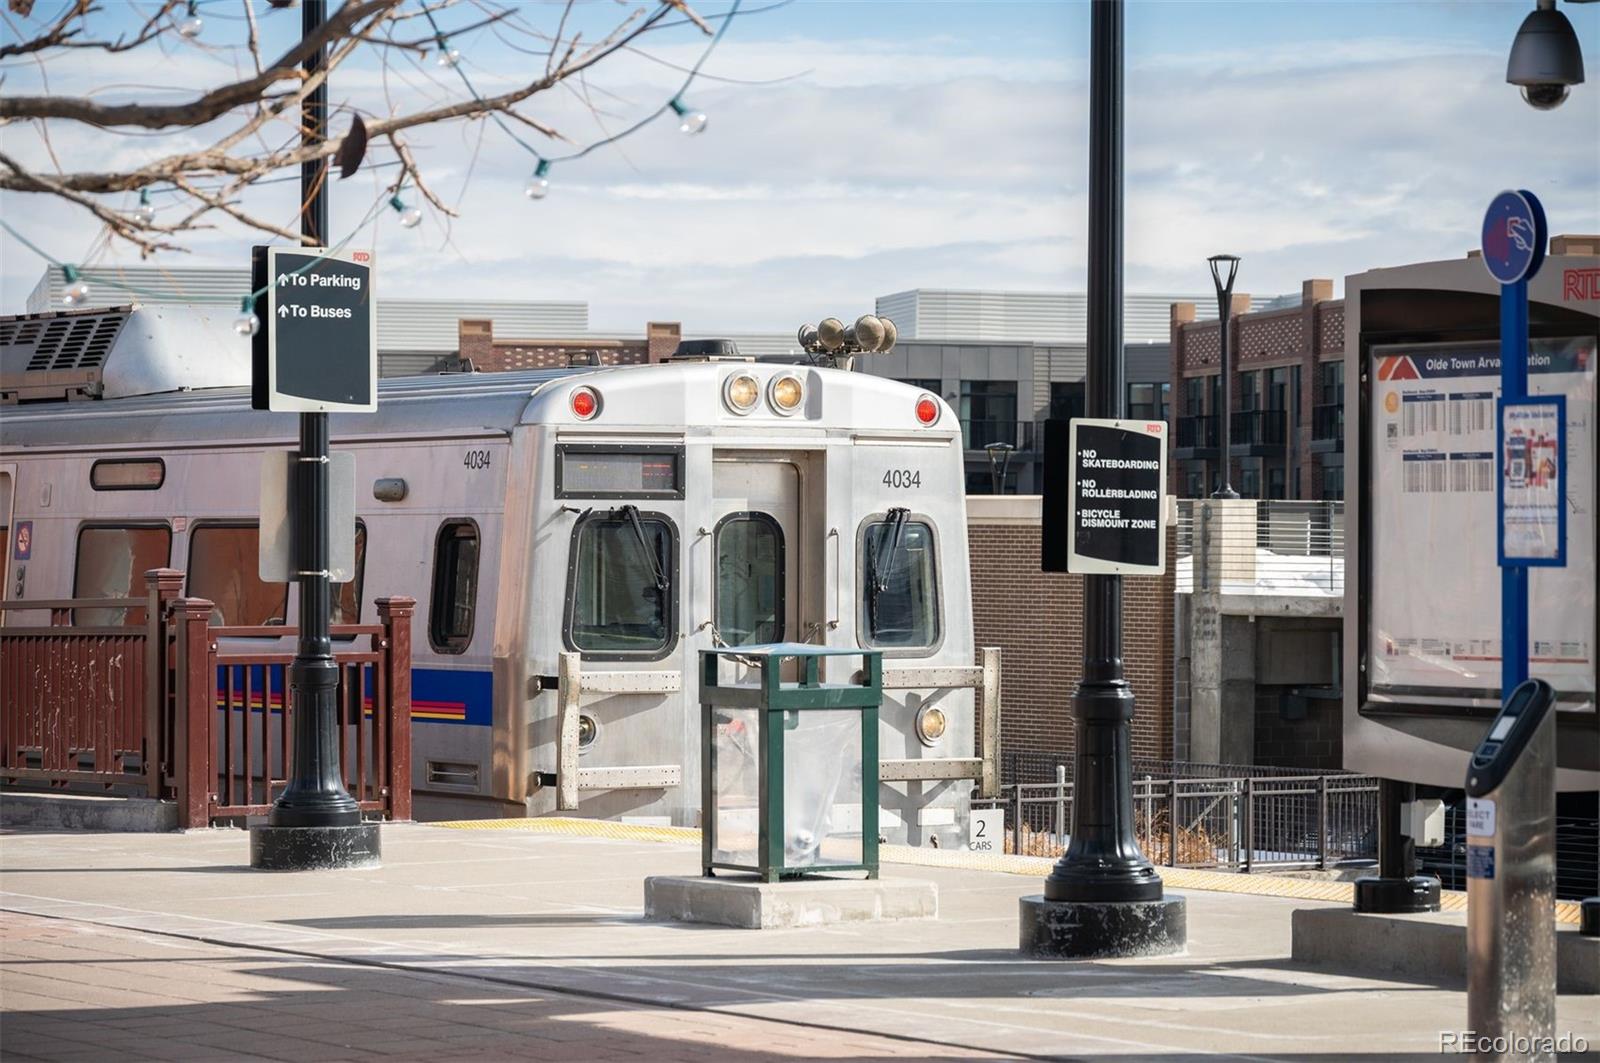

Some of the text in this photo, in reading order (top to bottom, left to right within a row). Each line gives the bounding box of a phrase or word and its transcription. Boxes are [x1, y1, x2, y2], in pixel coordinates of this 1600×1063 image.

[290, 273, 361, 290] To Parking
[290, 304, 352, 318] To Buses
[1426, 358, 1448, 371] Olde
[1450, 357, 1476, 369] Town
[1479, 356, 1502, 368] Arva
[463, 450, 491, 469] 4034
[1082, 449, 1097, 458] NO
[1082, 458, 1159, 470] SKATEBOARDING
[882, 469, 921, 488] 4034
[1081, 479, 1096, 488] NO
[1081, 488, 1157, 499] ROLLERBLADING
[1081, 509, 1121, 518] BICYCLE
[1081, 518, 1157, 529] DISMOUNT ZONE
[976, 819, 986, 837] 2
[969, 840, 992, 851] CARS
